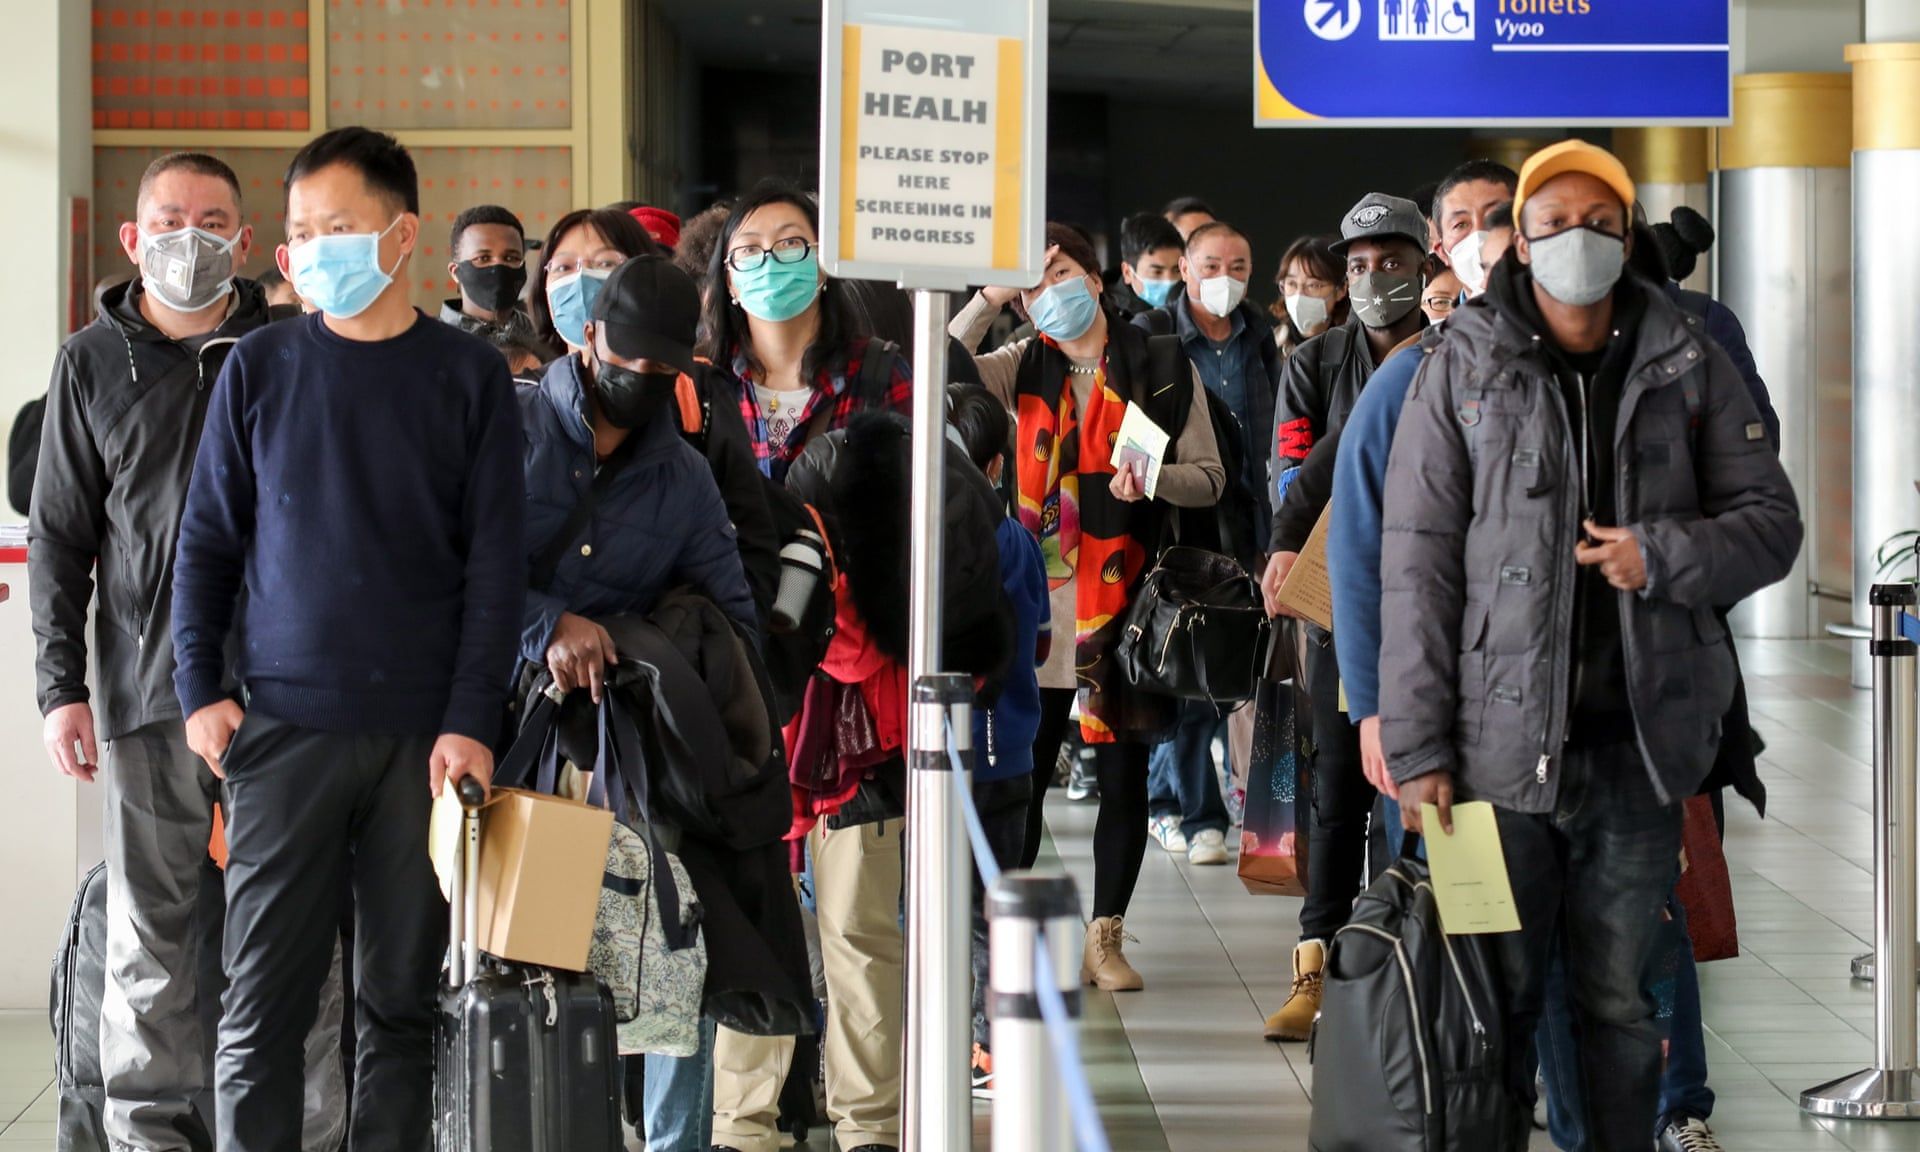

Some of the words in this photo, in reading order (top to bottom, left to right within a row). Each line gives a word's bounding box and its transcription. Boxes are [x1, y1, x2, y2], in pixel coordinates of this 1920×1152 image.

[1494, 18, 1545, 42] Vyoo
[881, 49, 975, 79] PORT
[864, 91, 988, 125] HEALH
[859, 145, 934, 163] PLEASE
[939, 149, 990, 165] STOP
[898, 174, 950, 190] HERE
[854, 199, 965, 218] SCREENING
[971, 205, 992, 219] IN
[871, 226, 975, 245] PROGRESS
